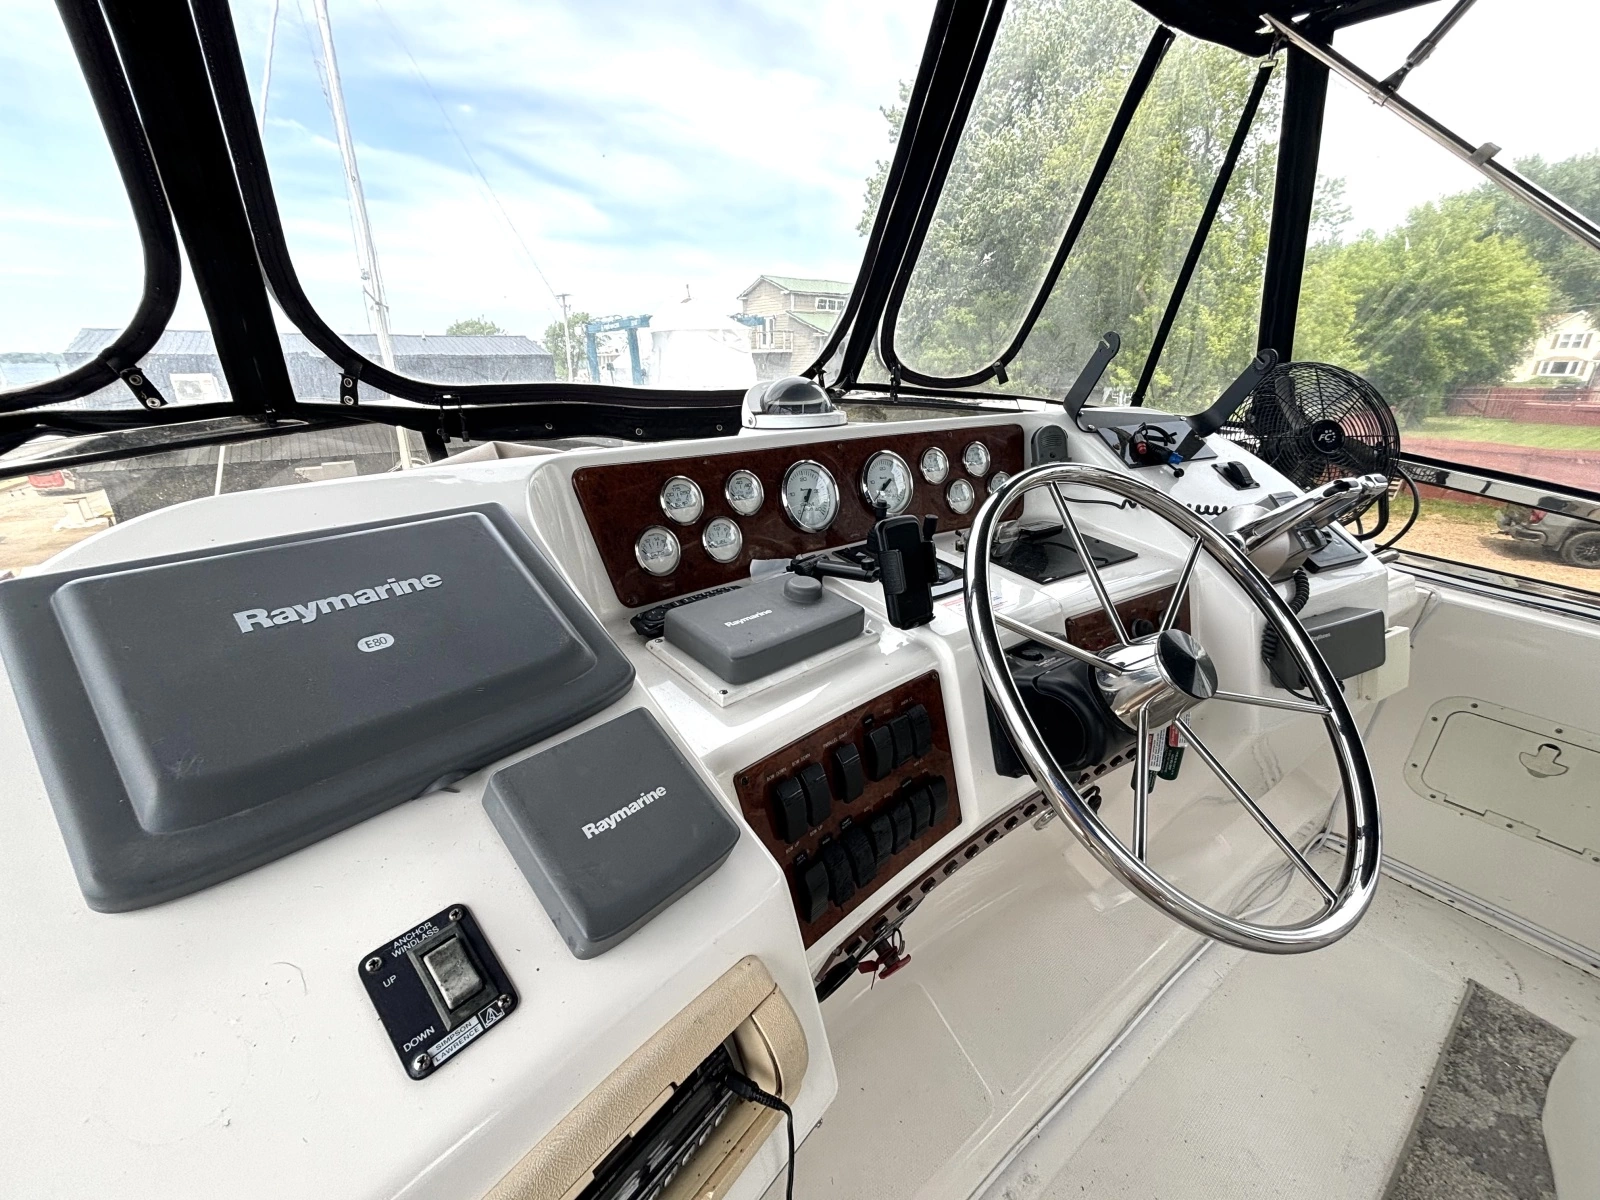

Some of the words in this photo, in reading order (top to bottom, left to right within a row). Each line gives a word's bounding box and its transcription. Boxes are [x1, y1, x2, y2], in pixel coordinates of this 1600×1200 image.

[232, 573, 443, 634] Raymarine
[723, 609, 773, 628] Raymarine
[365, 636, 388, 650] E80
[581, 786, 667, 840] Raymarine
[391, 926, 440, 958] WINDLASS
[393, 921, 432, 949] ANCHOR
[382, 974, 397, 988] UP
[403, 1025, 435, 1053] DOWN
[435, 1021, 472, 1051] SIMPSON
[435, 1027, 480, 1062] LAWRENCE
